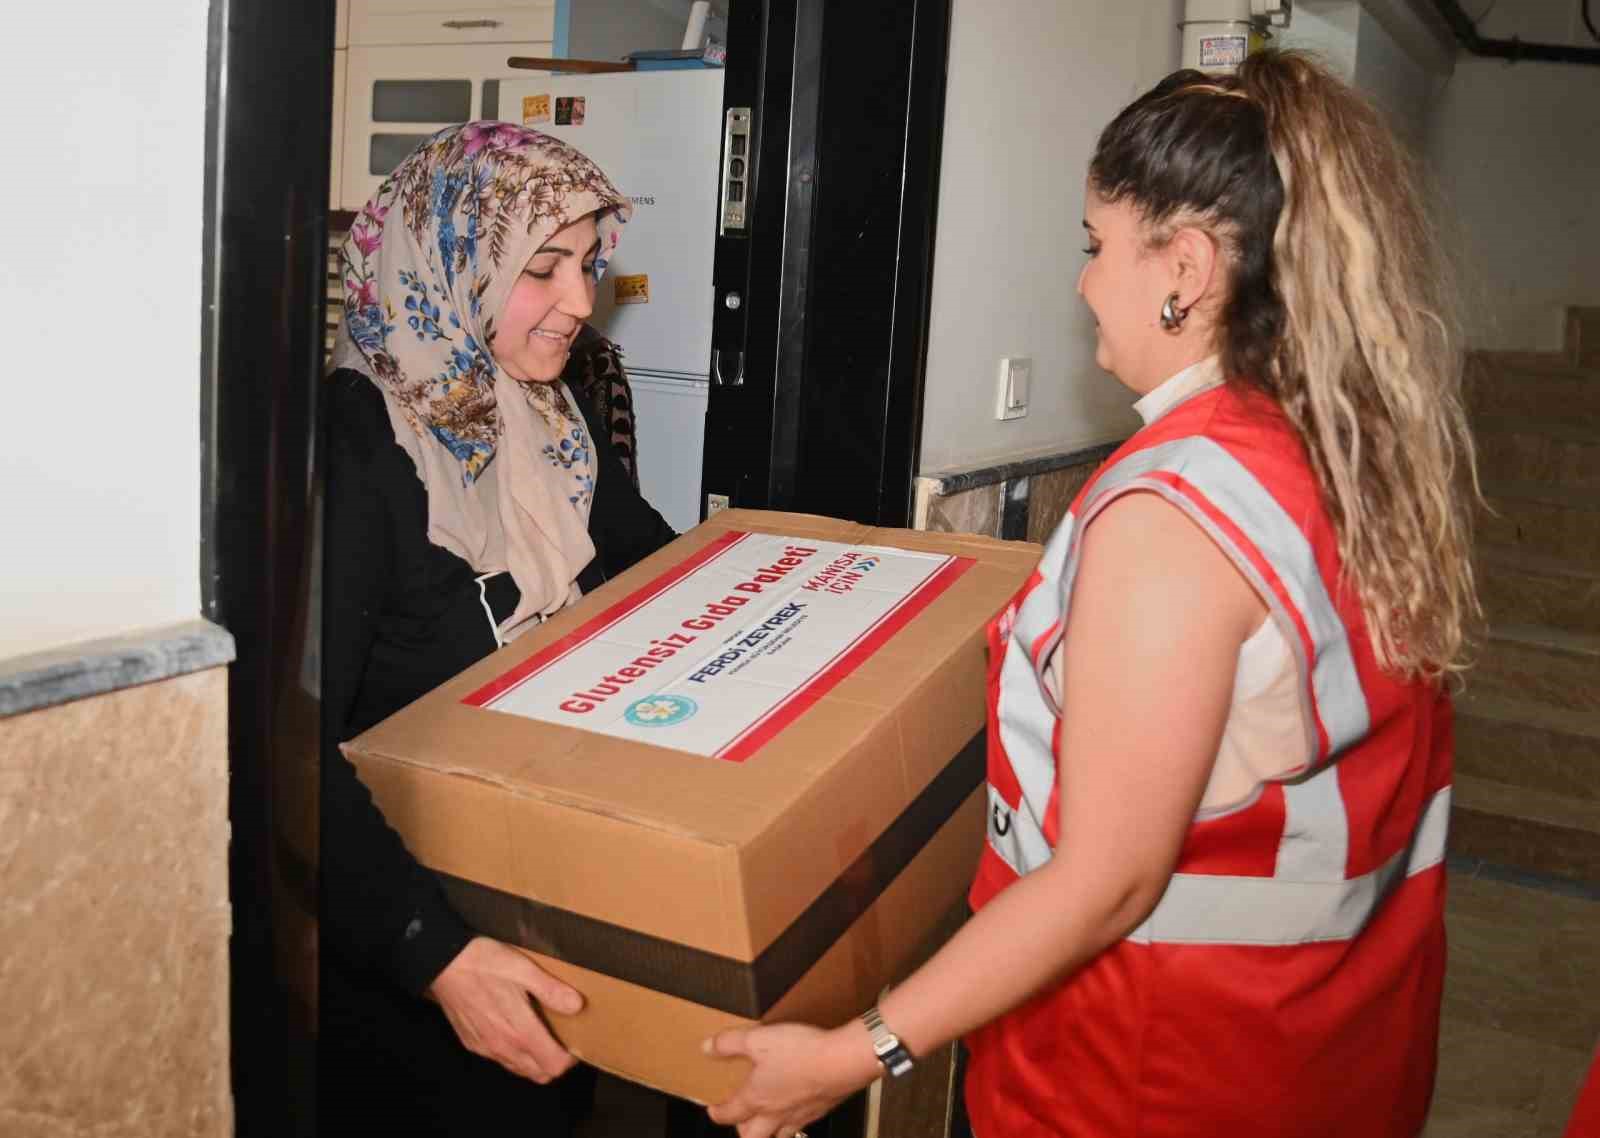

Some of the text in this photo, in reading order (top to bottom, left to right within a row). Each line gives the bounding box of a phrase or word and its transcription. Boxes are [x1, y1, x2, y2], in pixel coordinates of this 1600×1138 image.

[801, 552, 863, 591] MANİSA
[559, 633, 697, 713] Glutensiz
[681, 595, 751, 631] Gıda
[734, 545, 818, 593] Paketi
[687, 647, 747, 683] FERDİ
[736, 602, 808, 647] ZEYREK
